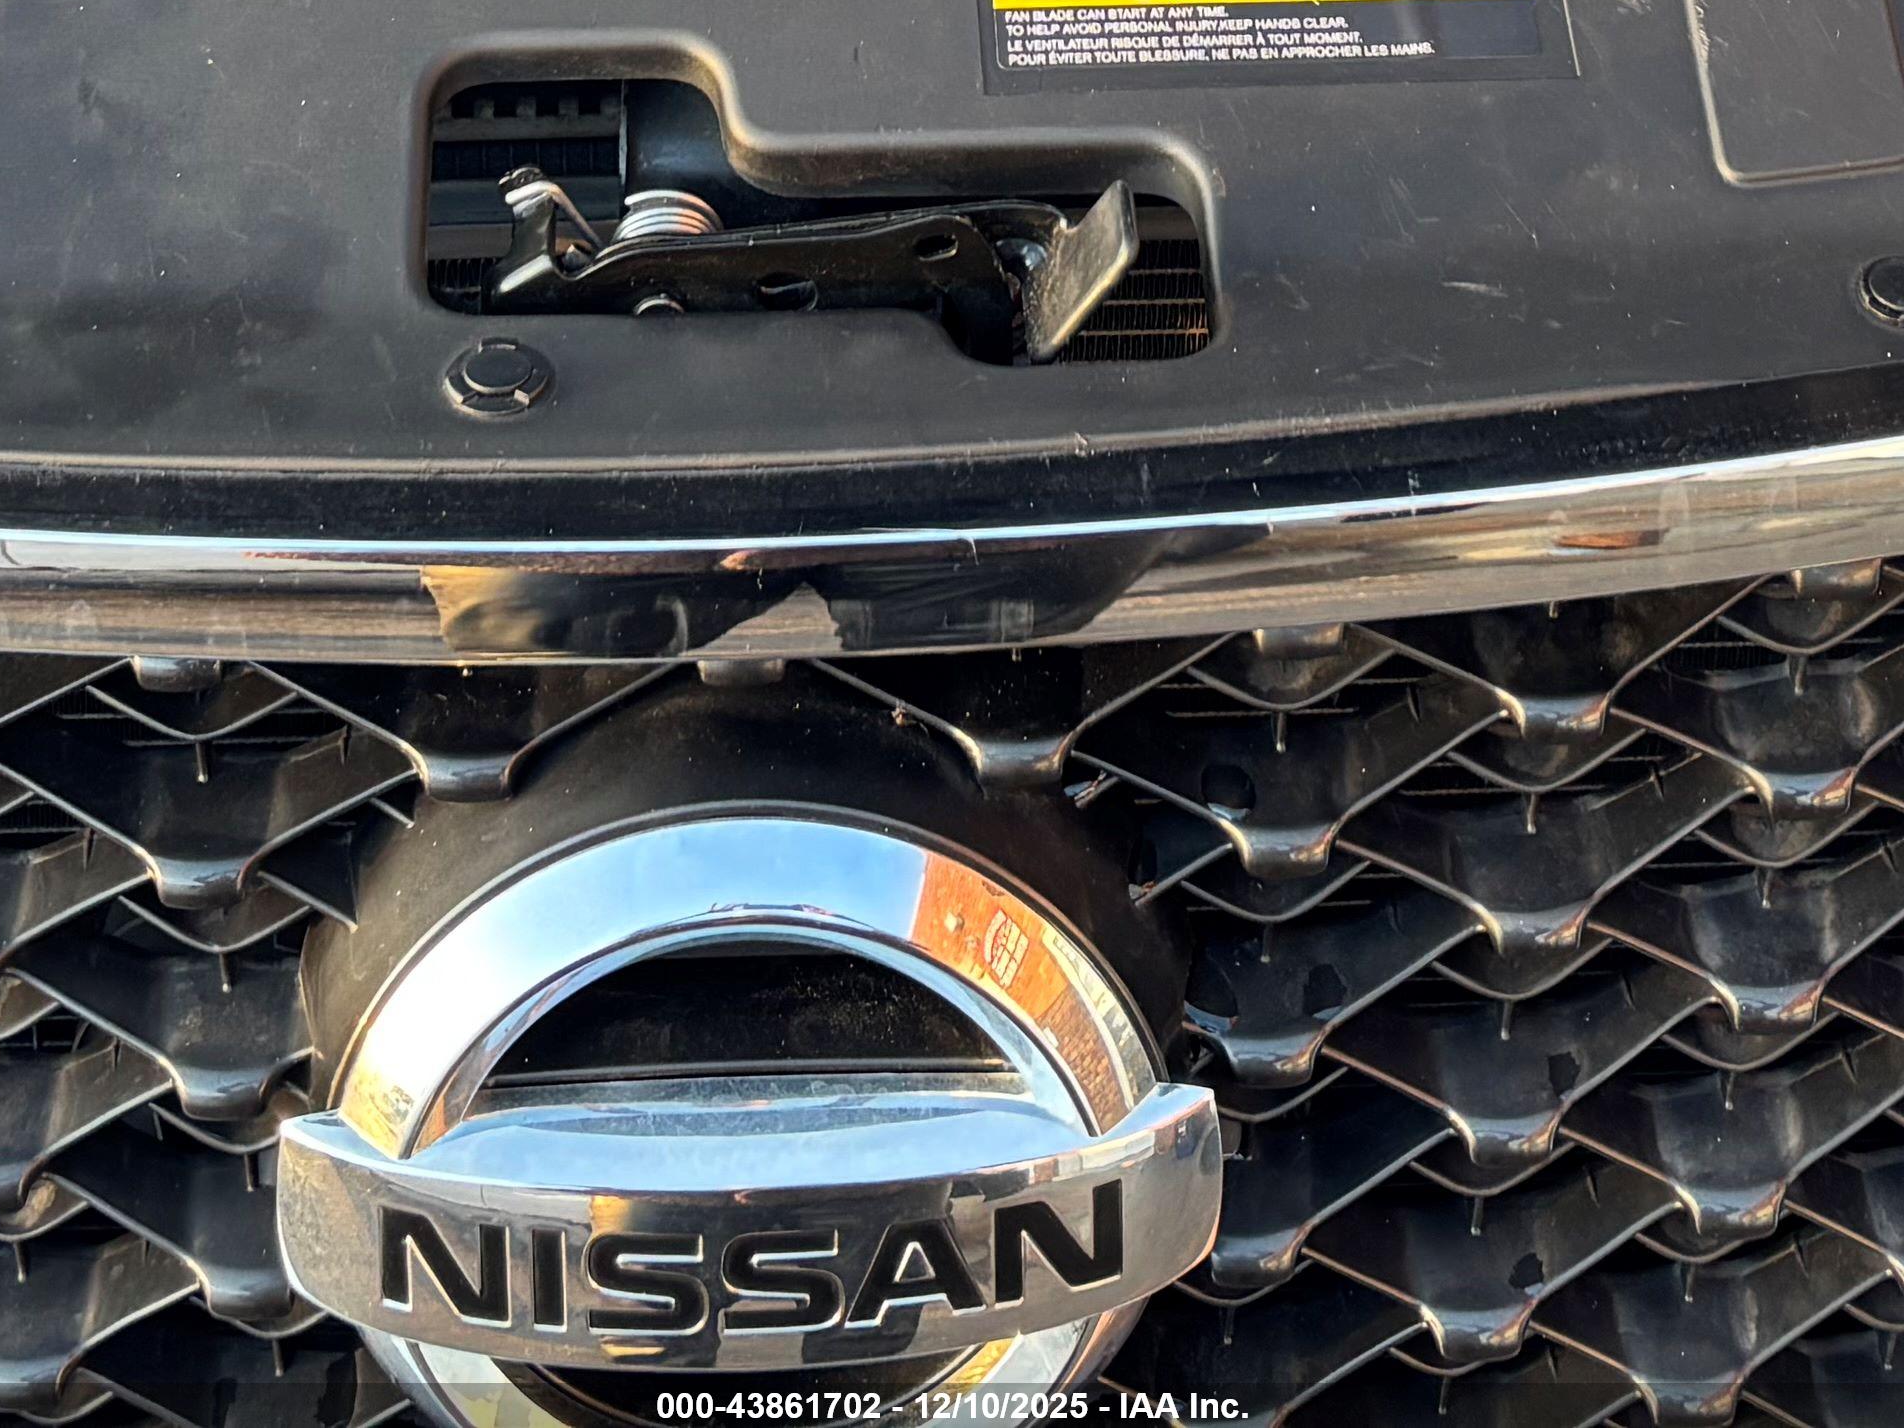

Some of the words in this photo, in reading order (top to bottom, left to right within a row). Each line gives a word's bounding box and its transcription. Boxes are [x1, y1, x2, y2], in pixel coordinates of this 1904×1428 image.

[1005, 10, 1030, 22] FAN
[1032, 9, 1075, 21] BLADE
[1077, 8, 1106, 20] CAN
[1108, 7, 1147, 19] START
[1149, 6, 1165, 19] AT
[1168, 6, 1194, 18] ANY
[1197, 5, 1229, 17] TIME.
[1006, 24, 1024, 36] TO
[1026, 23, 1061, 36] HELP
[1062, 22, 1101, 35] AVOID
[1104, 20, 1173, 34] PERSONAL
[1256, 17, 1301, 30] HANDS
[1303, 16, 1348, 29] CLEAR.
[1008, 40, 1024, 52] LE
[1025, 38, 1108, 52] VENTILATEUR
[1111, 36, 1159, 49] RISQUE
[1162, 35, 1180, 47] DE
[1185, 31, 1254, 48] DÉMARRER
[1268, 32, 1302, 44] TOUT
[1304, 30, 1363, 43] MOMENT.
[1008, 53, 1046, 66] POUR
[1049, 49, 1092, 64] ÉVITER
[1095, 50, 1136, 63] TOUTE
[1212, 48, 1230, 60] NE
[1232, 47, 1257, 60] PAS
[1261, 46, 1278, 58] EN
[1281, 44, 1362, 58] APPROCHER
[1364, 43, 1388, 56] LES
[377, 1178, 1125, 1338] NISSAN
